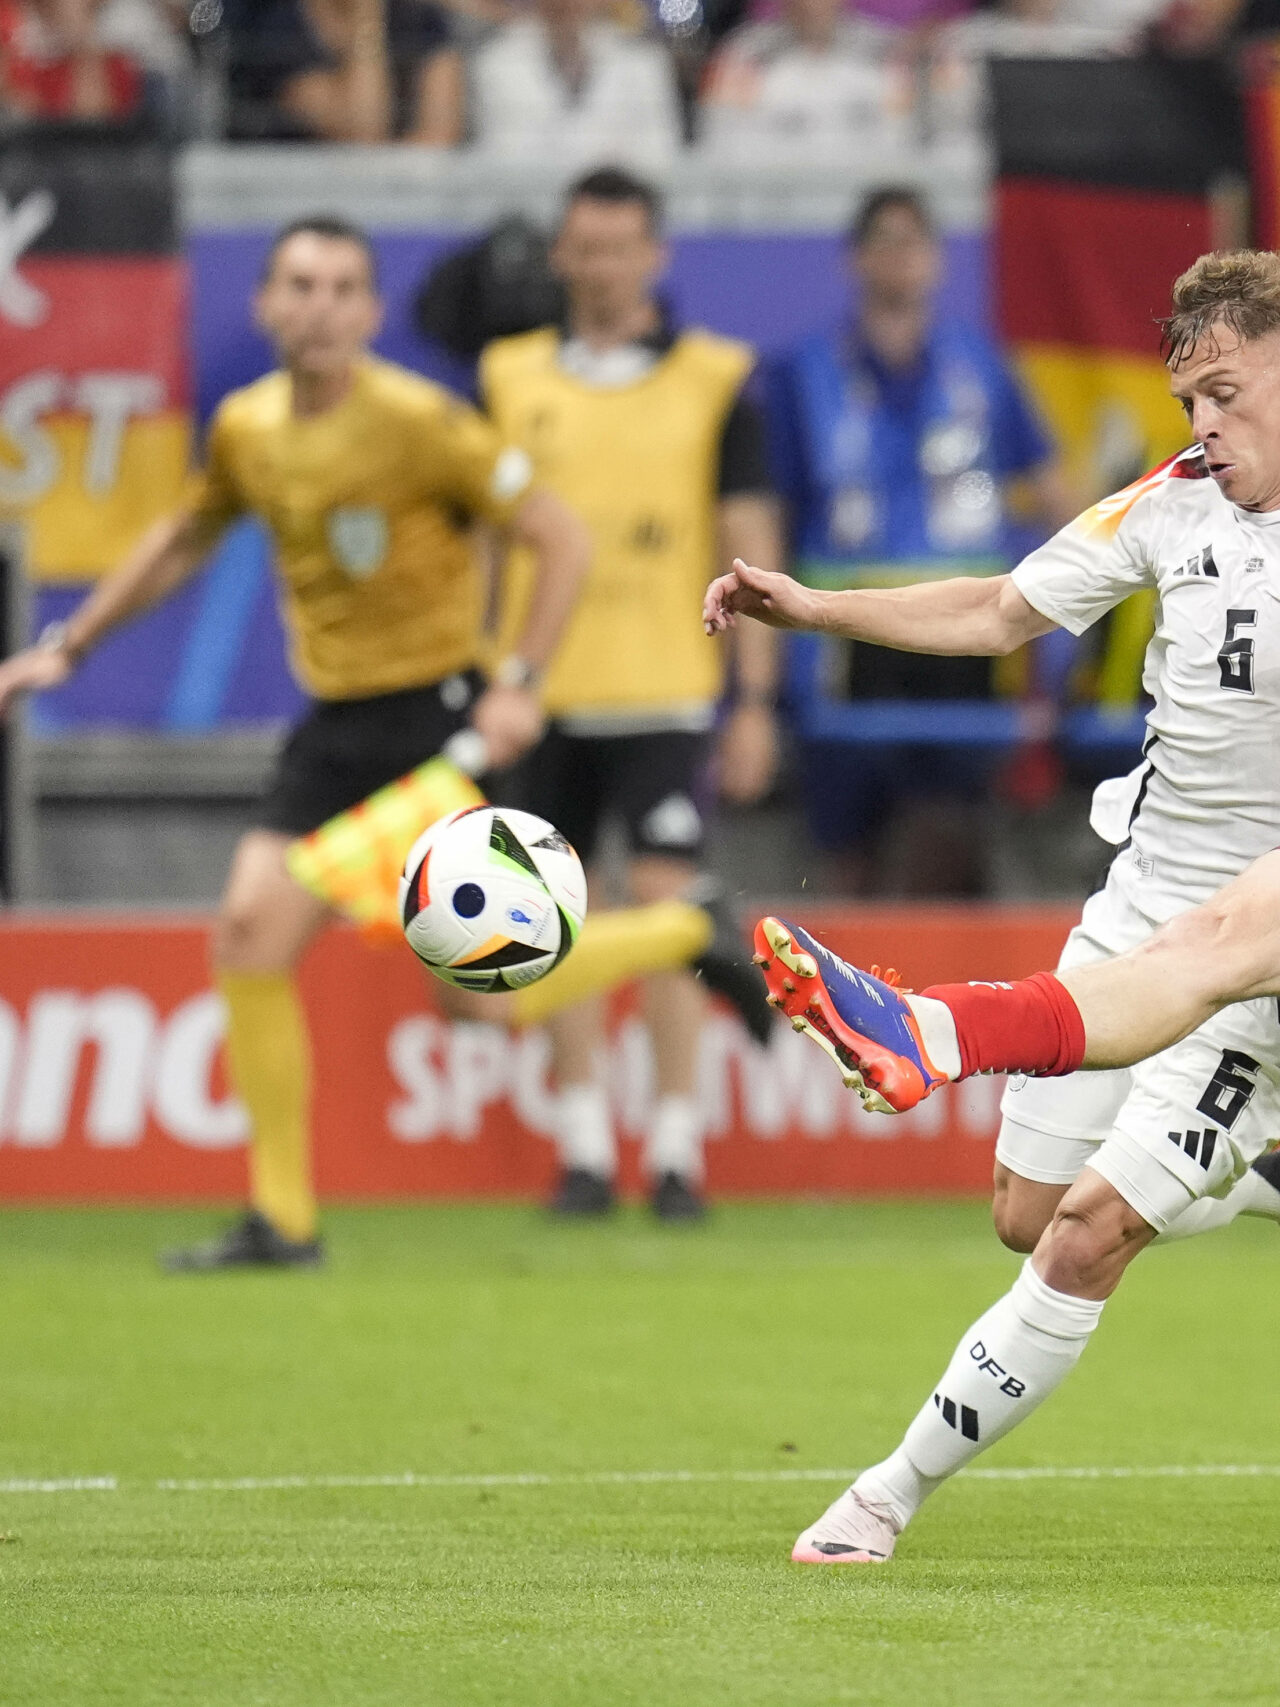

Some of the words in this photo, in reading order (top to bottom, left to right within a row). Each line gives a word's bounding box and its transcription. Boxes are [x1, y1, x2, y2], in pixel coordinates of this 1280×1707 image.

[1217, 608, 1258, 695] 6
[1196, 1048, 1262, 1134] 6
[969, 1340, 1026, 1398] DFB
